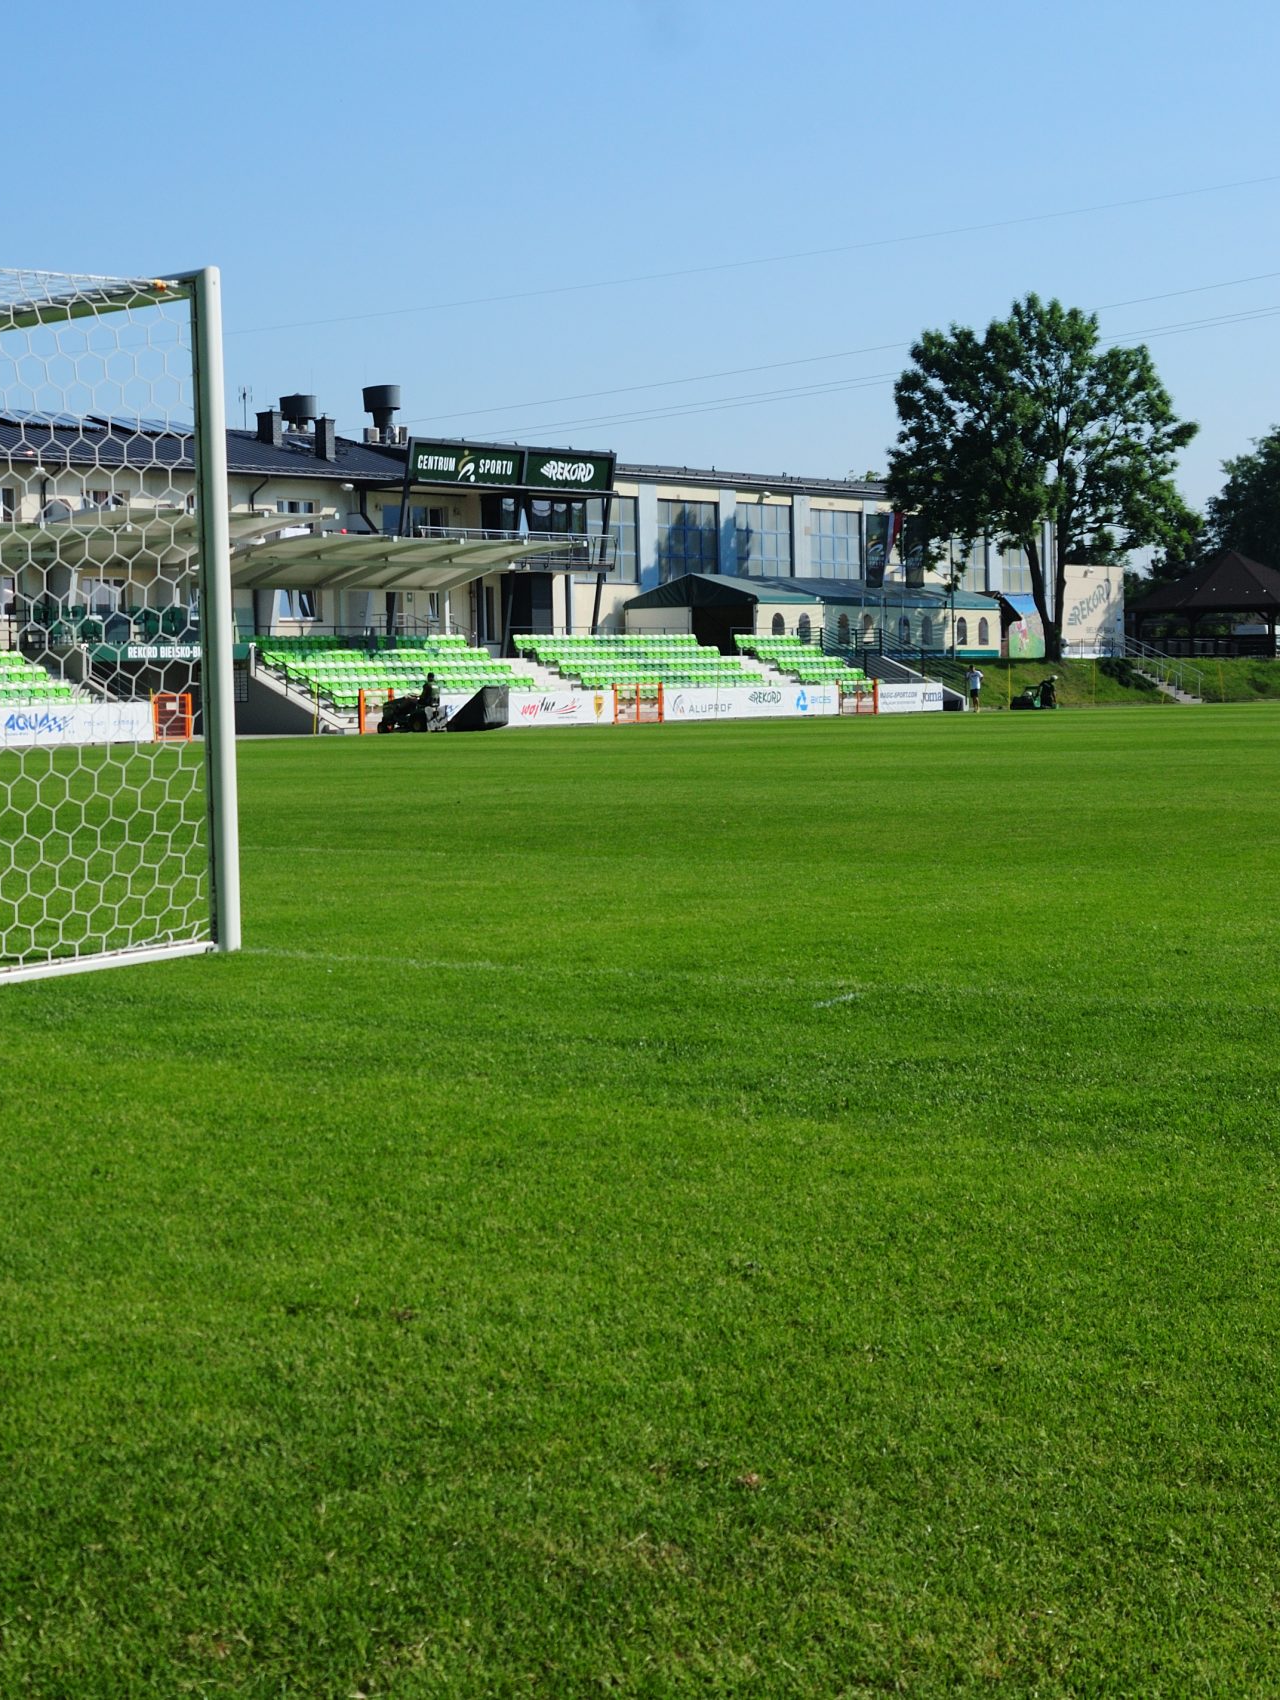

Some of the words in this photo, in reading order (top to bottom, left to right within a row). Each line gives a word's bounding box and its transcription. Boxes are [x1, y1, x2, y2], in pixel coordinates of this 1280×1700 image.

[417, 455, 455, 472] CENTRUM
[479, 458, 513, 476] SPORTU
[547, 460, 595, 483] REKORD
[1072, 578, 1112, 625] REKORD
[127, 646, 158, 659] REKORD
[159, 646, 203, 659] BIELSKO-BI
[752, 691, 782, 704] REKORD
[520, 697, 556, 720] wojtur
[688, 703, 733, 714] ALUPROF
